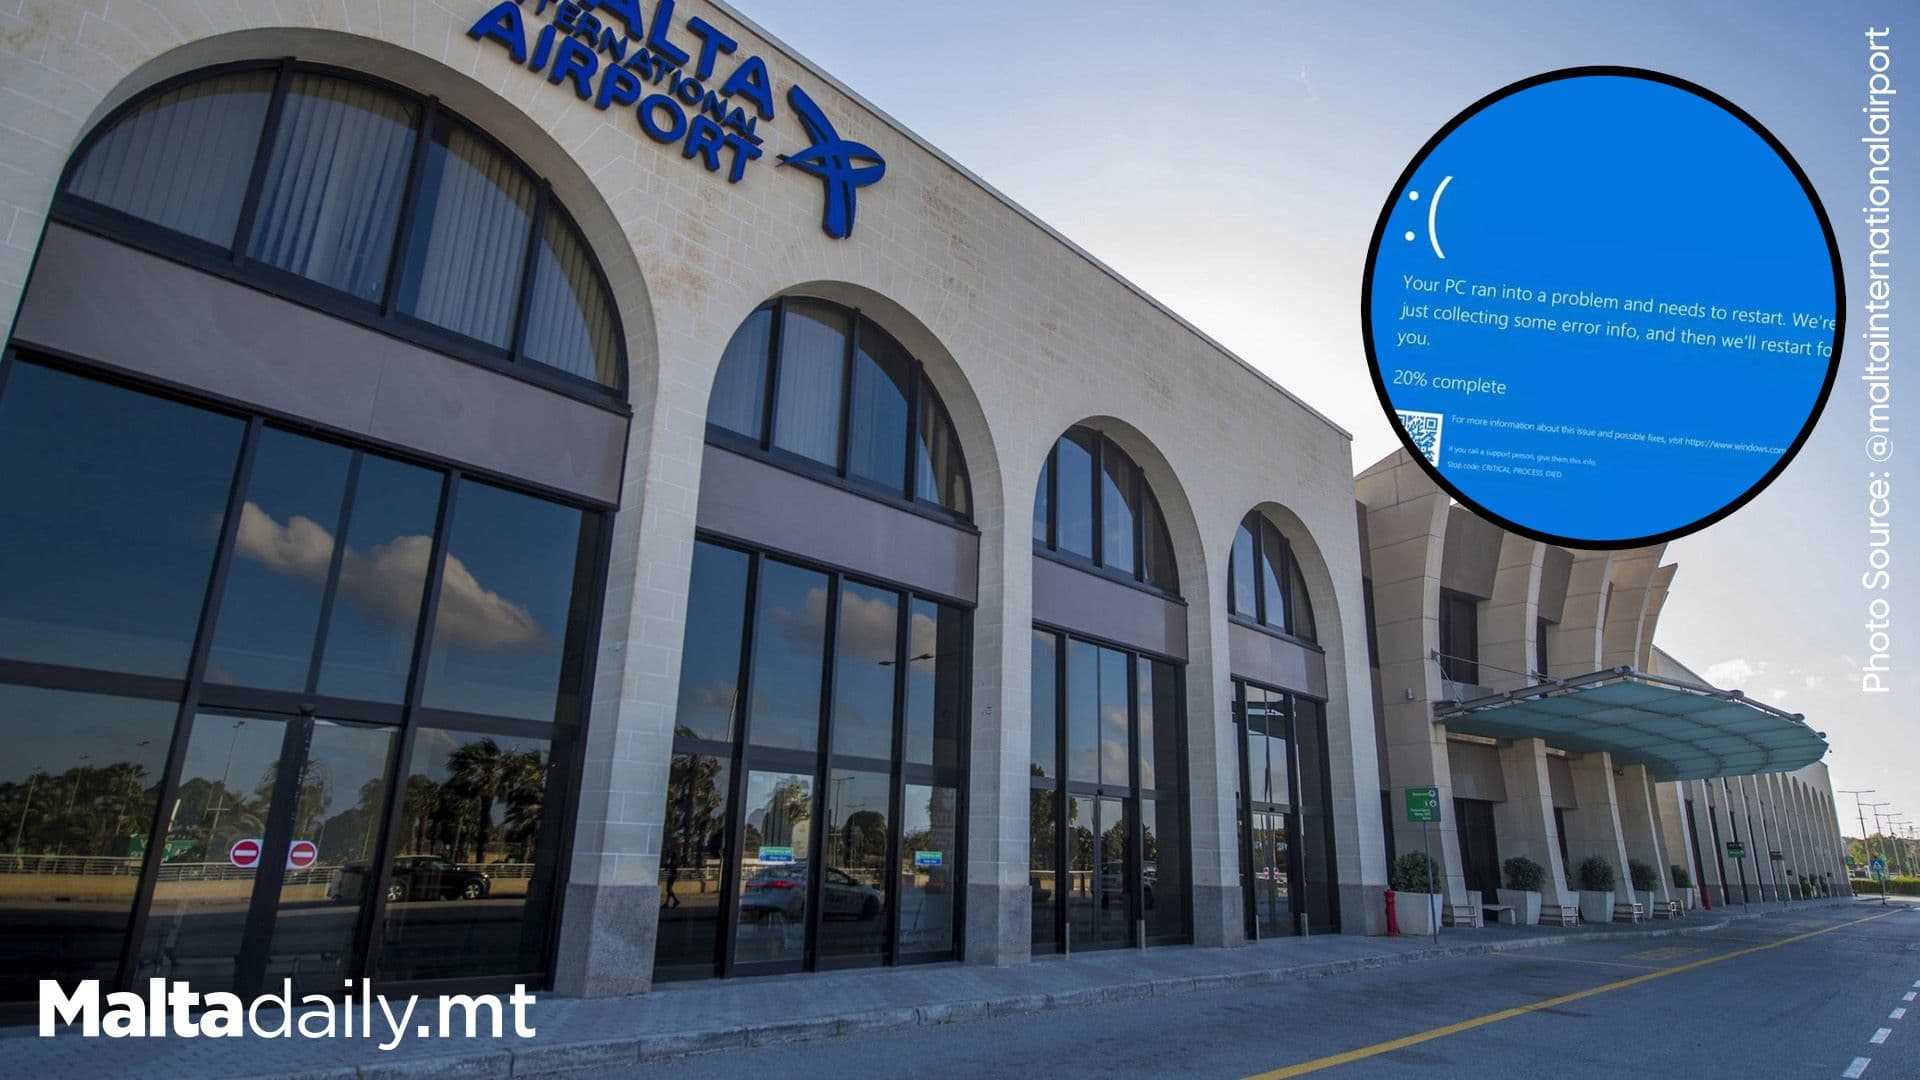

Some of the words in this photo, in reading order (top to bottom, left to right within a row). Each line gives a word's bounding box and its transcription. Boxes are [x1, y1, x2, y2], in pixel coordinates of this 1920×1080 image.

[576, 0, 775, 121] ALTA
[466, 1, 764, 184] AIRPORT
[1403, 275, 1440, 292] Your
[1445, 278, 1467, 295] PC
[1471, 284, 1496, 298] ran
[1502, 284, 1532, 302] into
[1537, 291, 1547, 303] a
[1551, 291, 1619, 310] problem
[1623, 298, 1653, 313] and
[1658, 302, 1706, 318] needs
[1711, 306, 1727, 320] to
[1732, 309, 1786, 326] restart.
[1792, 311, 1837, 331] We're
[1397, 331, 1430, 347] you.
[1399, 302, 1429, 320] just
[1433, 304, 1509, 330] collecting
[1514, 315, 1557, 331] some
[1562, 320, 1602, 336] error
[1606, 321, 1641, 340] info,
[1645, 327, 1676, 343] and
[1680, 330, 1716, 346] then
[1721, 334, 1756, 350] we'll
[1761, 339, 1812, 356] restart
[1393, 369, 1428, 388] 20%
[1432, 374, 1507, 396] complete
[1451, 414, 1465, 424] For
[1466, 417, 1488, 426] more
[1489, 417, 1535, 430] information
[1536, 423, 1560, 433] about
[1561, 425, 1575, 435] this
[1576, 428, 1597, 437] issue
[1597, 430, 1614, 439] and
[1614, 430, 1646, 442] possible
[1668, 435, 1684, 445] visit
[1454, 447, 1467, 455] you
